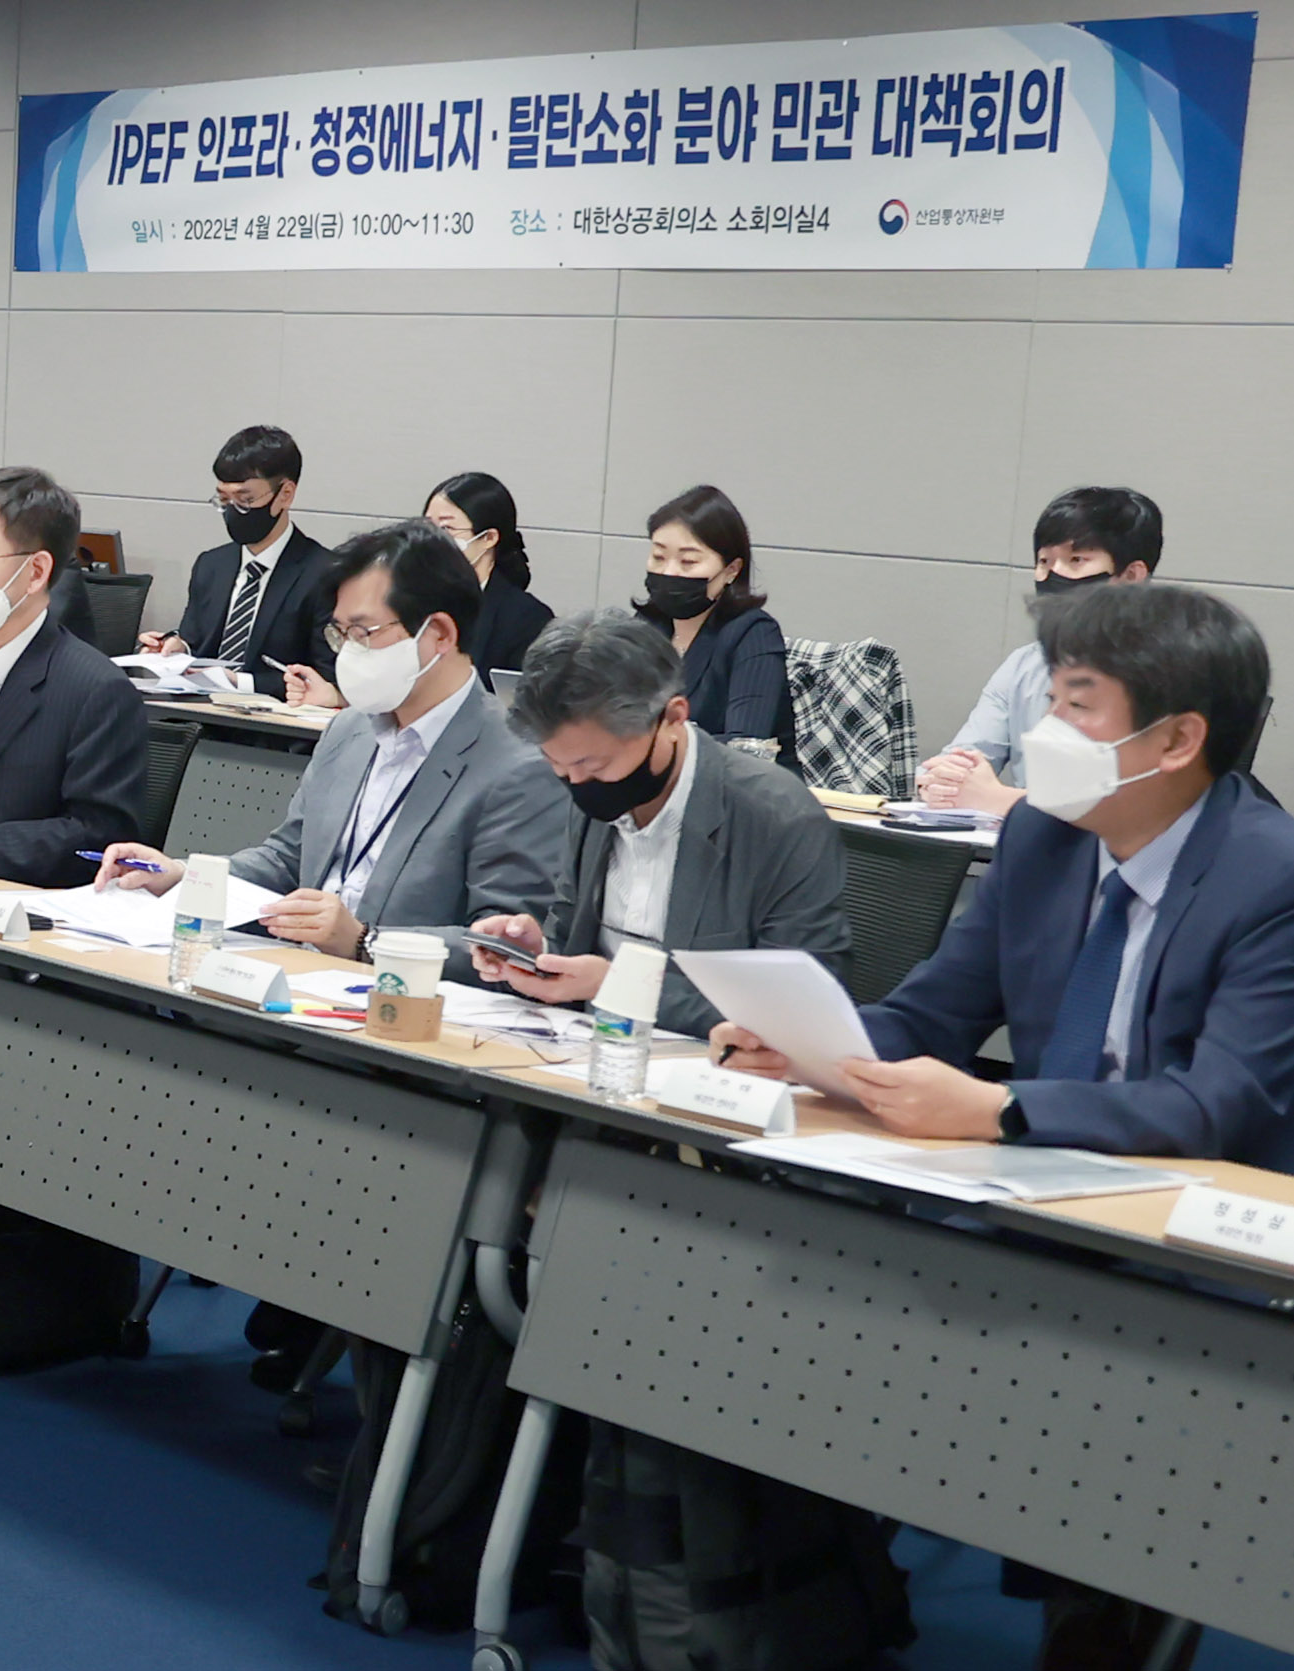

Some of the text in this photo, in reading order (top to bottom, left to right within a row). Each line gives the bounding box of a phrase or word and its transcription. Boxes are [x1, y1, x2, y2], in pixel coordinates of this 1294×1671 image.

[107, 121, 189, 186] IPEF
[674, 84, 760, 164] 분야
[770, 79, 861, 161] 민관
[871, 67, 1066, 158] 대책회의
[131, 219, 164, 244] 일시
[183, 216, 239, 242] 2022년
[244, 214, 271, 241] 4월
[277, 211, 345, 241] 22일(금)
[351, 212, 475, 236] 10:00~11:30
[510, 208, 547, 236] 장소
[573, 206, 719, 235] 대한상공회의소
[726, 204, 831, 232] 소회의실4
[915, 207, 1005, 227] 산업통상자원부
